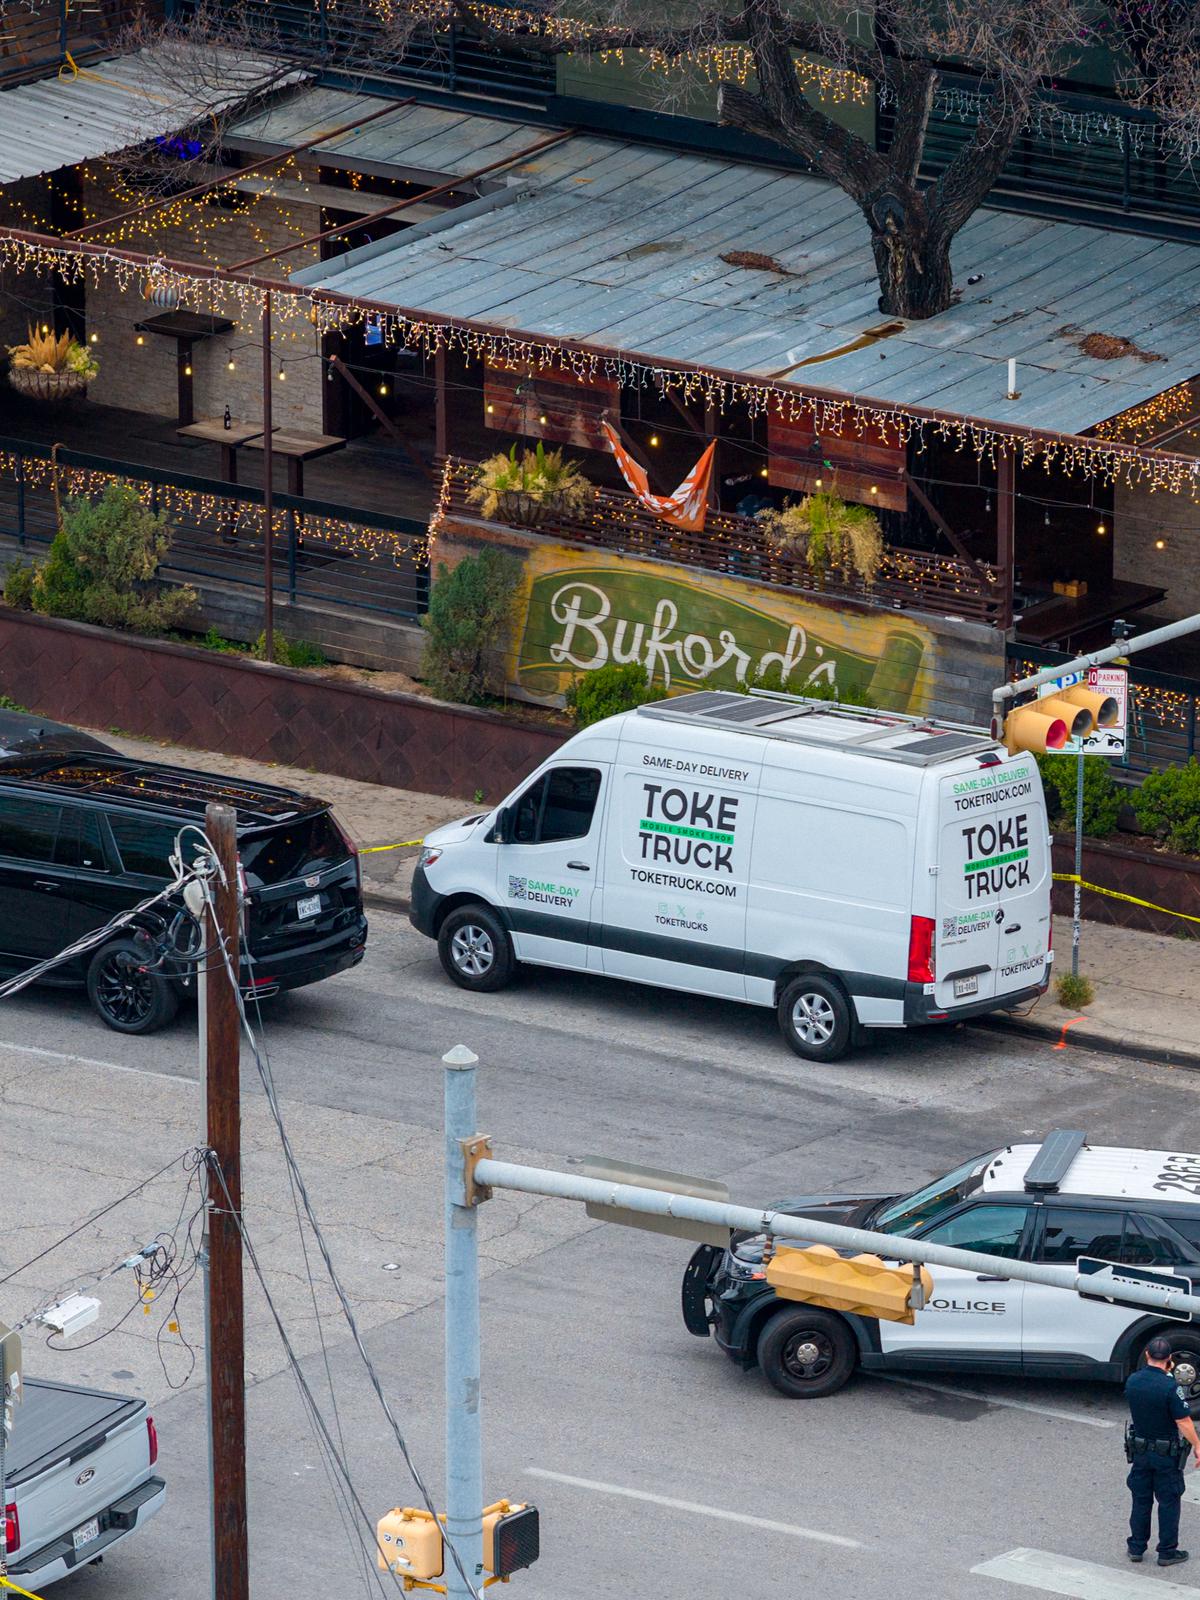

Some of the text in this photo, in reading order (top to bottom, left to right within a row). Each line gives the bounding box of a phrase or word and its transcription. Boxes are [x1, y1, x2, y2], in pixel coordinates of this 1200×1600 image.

[1098, 673, 1124, 682] PARKING
[643, 755, 749, 781] SAME-DAY DELIVERY
[953, 767, 1030, 794] SAME-DAY DELIVERY
[643, 783, 739, 832] TOKE
[955, 782, 1032, 811] TOKETRUCK.COM
[642, 822, 732, 842] MOBILE SMOKE SHOP
[962, 813, 1029, 860] TOKE
[639, 831, 733, 873] TRUCK
[528, 879, 580, 897] SAME-DAY
[630, 868, 737, 897] TOKETRUCK.COM
[964, 860, 1030, 900] TRUCK
[528, 891, 574, 907] DELIVERY
[655, 915, 709, 932] TOKETRUCKS
[958, 909, 995, 925] SAME-DAY
[958, 921, 991, 935] DELIVERY
[1001, 955, 1044, 977] TOKETRUCKS
[932, 1299, 1006, 1312] OLICE
